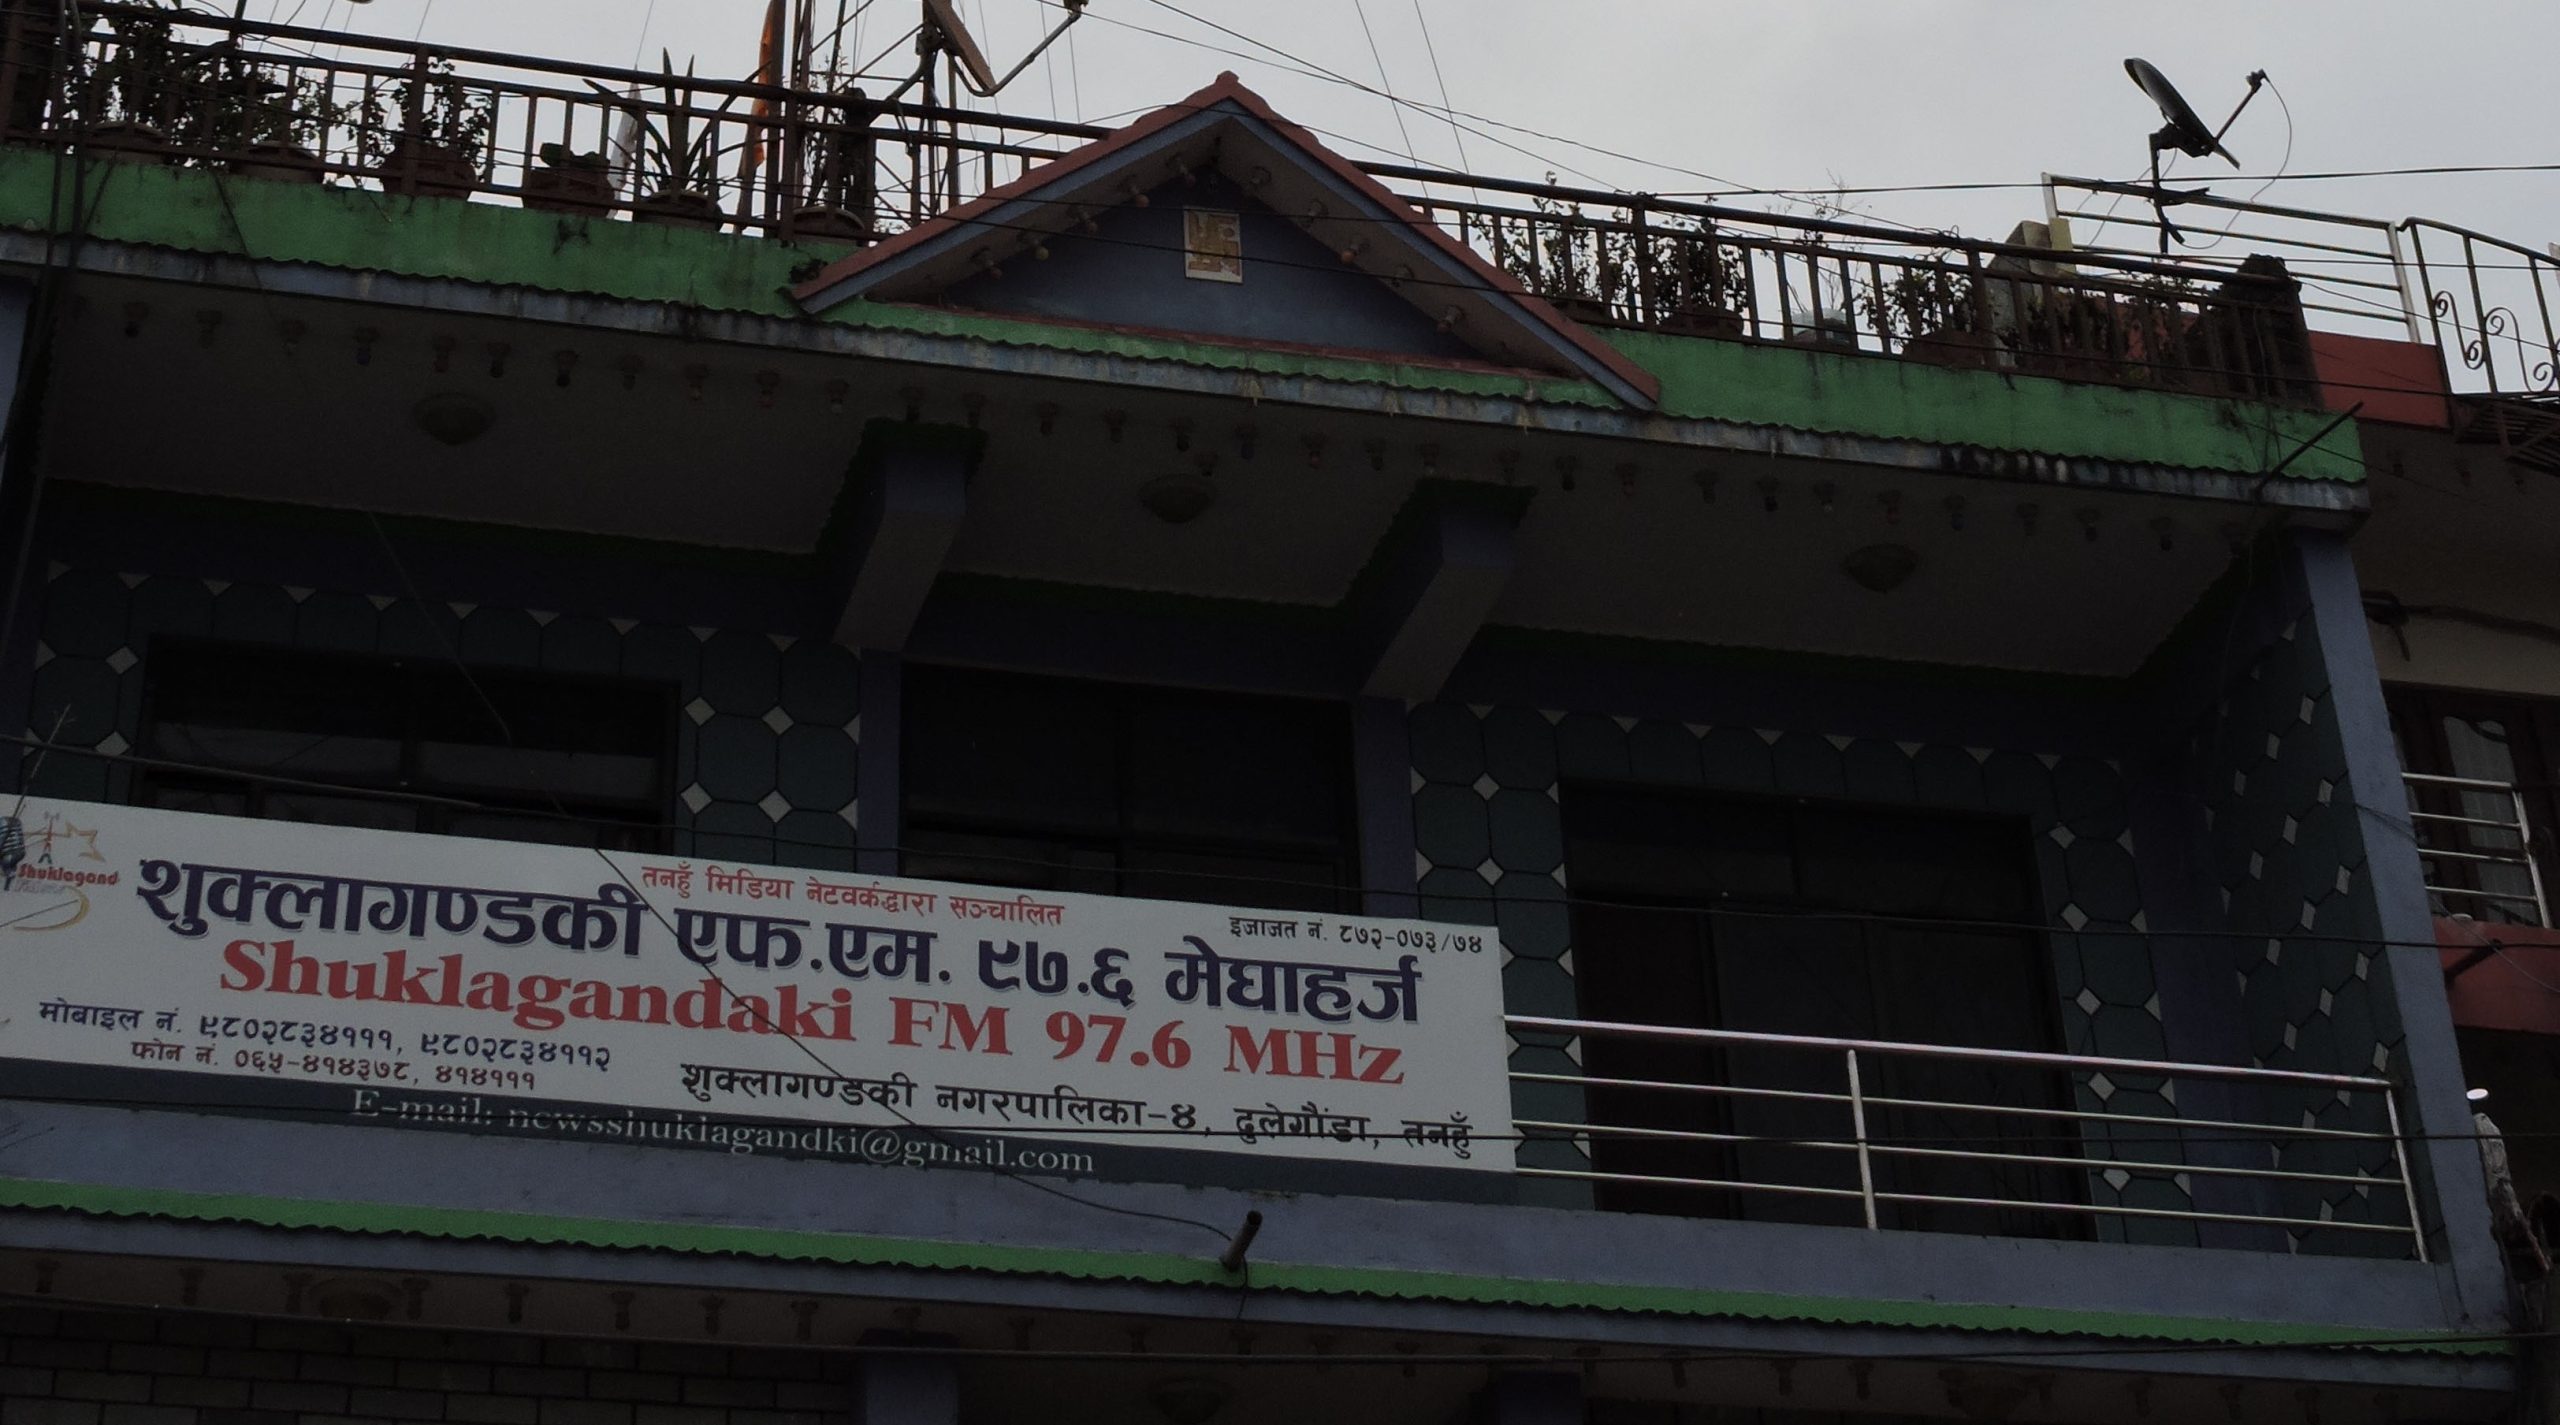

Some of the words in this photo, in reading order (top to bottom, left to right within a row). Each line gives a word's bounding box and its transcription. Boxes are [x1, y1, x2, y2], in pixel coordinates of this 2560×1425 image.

[705, 864, 795, 900] मिडिया
[137, 859, 649, 958] शुक्लागण्डकी
[978, 937, 1133, 1008] ९७.६
[1165, 935, 1421, 1023] मेघाहर्ज
[1229, 916, 1298, 938] इजाजत
[1340, 924, 1483, 953] ८७२-०७३/७४
[39, 996, 144, 1031] मोबाइल
[421, 1032, 611, 1072] ९८०२८३४११२
[221, 939, 856, 1042] Shuklagandaki
[888, 994, 1012, 1055] FM
[1045, 1010, 1192, 1070] 97.6
[1223, 1024, 1405, 1085] MHz
[131, 1037, 186, 1063] फोन
[435, 1065, 535, 1091] ४१४१११
[681, 1063, 918, 1108] शुक्लागण्डकी
